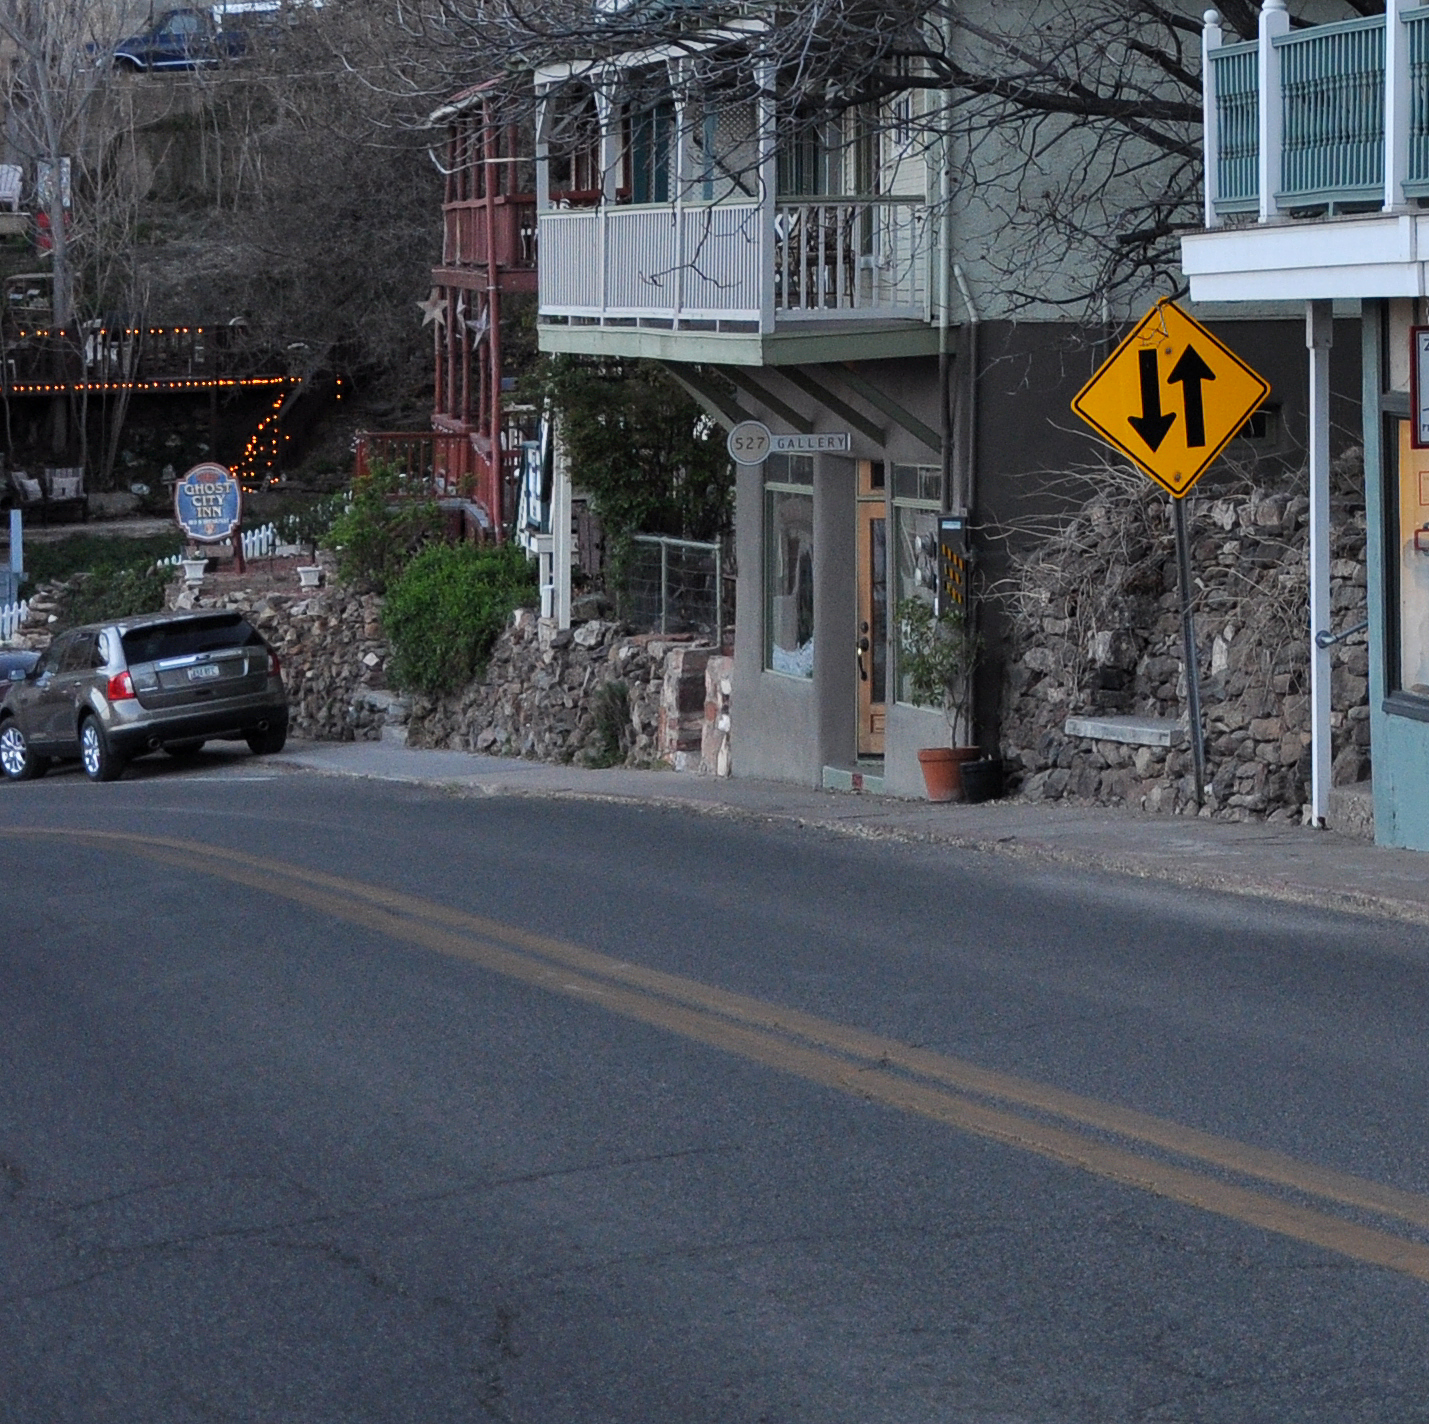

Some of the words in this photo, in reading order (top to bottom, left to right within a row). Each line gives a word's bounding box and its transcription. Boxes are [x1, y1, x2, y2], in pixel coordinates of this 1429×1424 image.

[735, 437, 765, 451] 527
[777, 437, 845, 449] GALLERY
[184, 482, 232, 495] GHOST
[192, 495, 225, 507] CITY
[197, 506, 222, 518] INN
